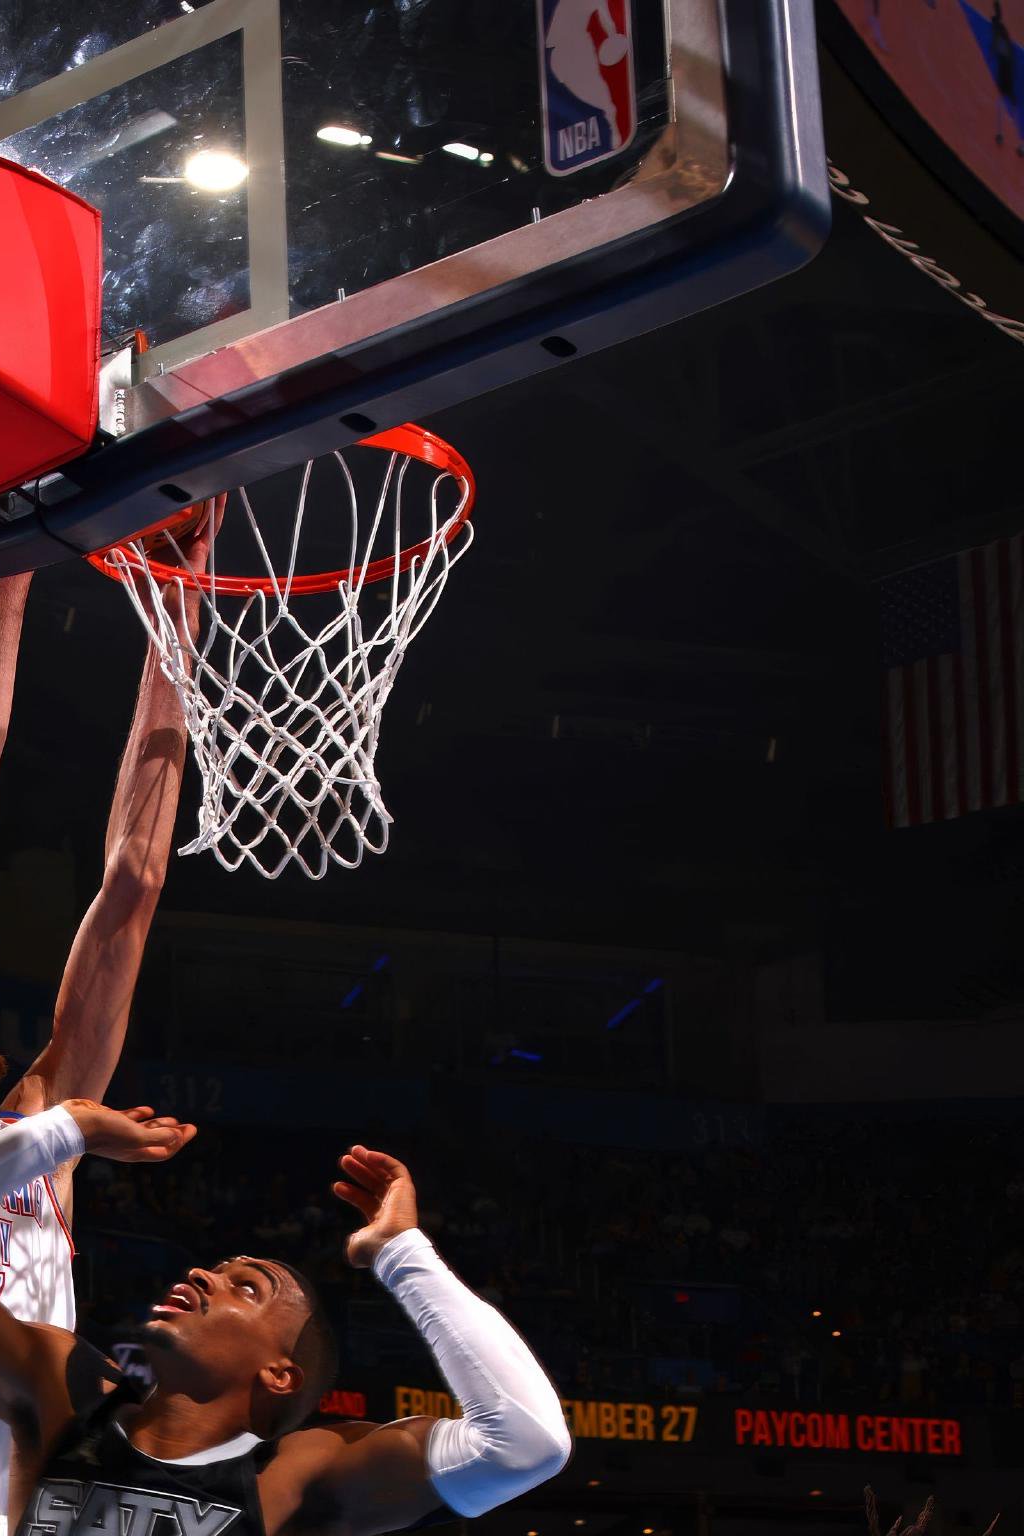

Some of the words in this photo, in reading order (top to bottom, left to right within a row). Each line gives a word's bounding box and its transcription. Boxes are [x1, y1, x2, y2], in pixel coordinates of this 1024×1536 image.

[559, 116, 601, 161] NBA
[660, 1403, 698, 1442] 27
[734, 1407, 850, 1449] PAYCOM
[855, 1412, 964, 1456] CENTER
